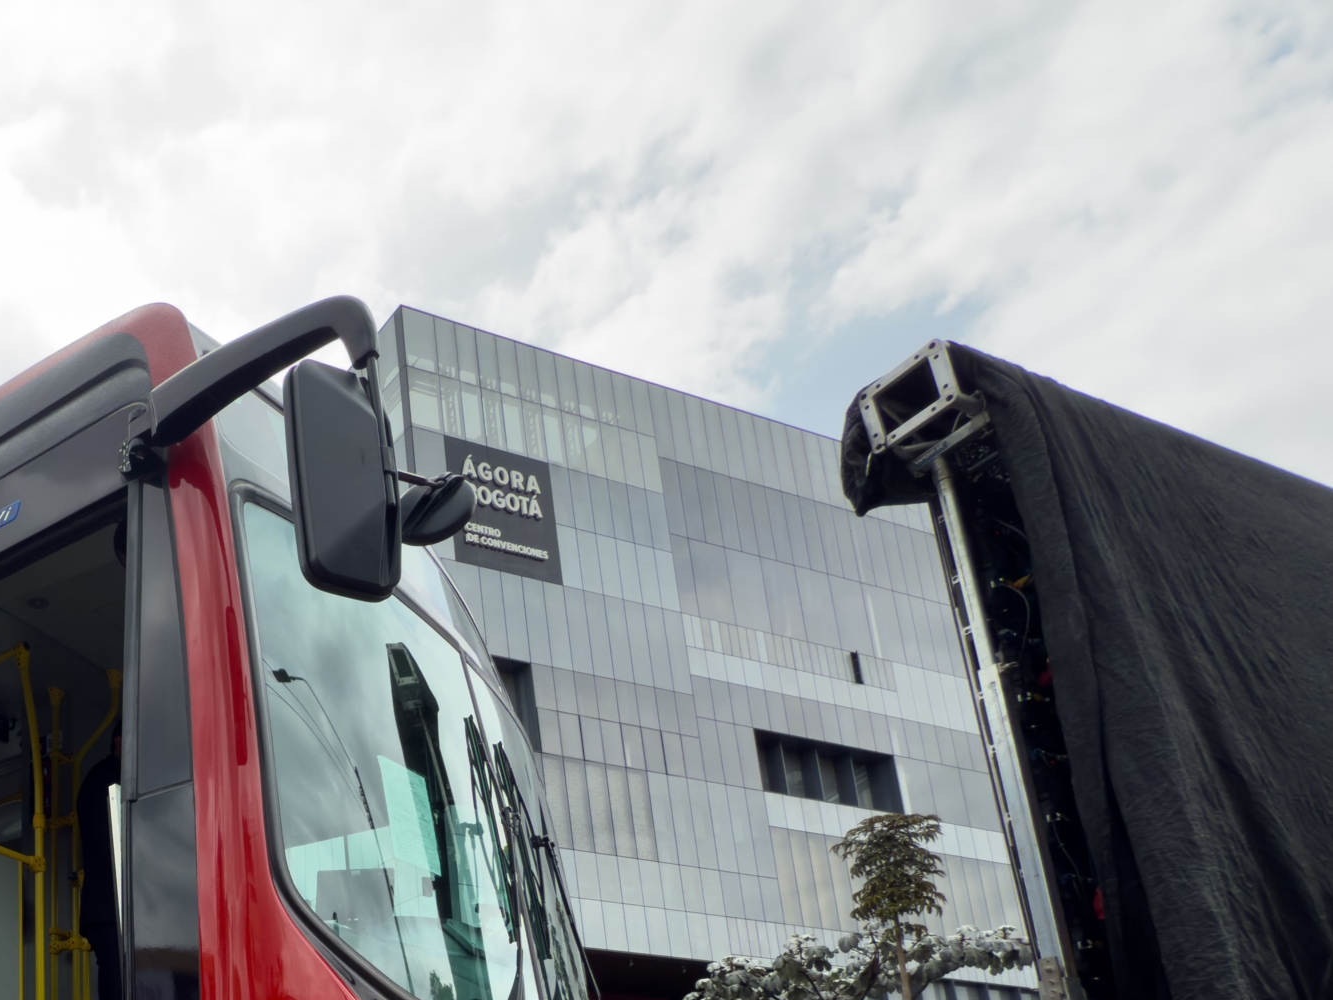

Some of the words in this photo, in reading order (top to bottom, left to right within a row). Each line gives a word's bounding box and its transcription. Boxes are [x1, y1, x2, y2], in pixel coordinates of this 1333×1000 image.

[461, 454, 542, 494] ÁGORA
[464, 521, 502, 538] CENTRO
[465, 532, 480, 545] DE
[480, 536, 549, 560] CONVENCIONES
